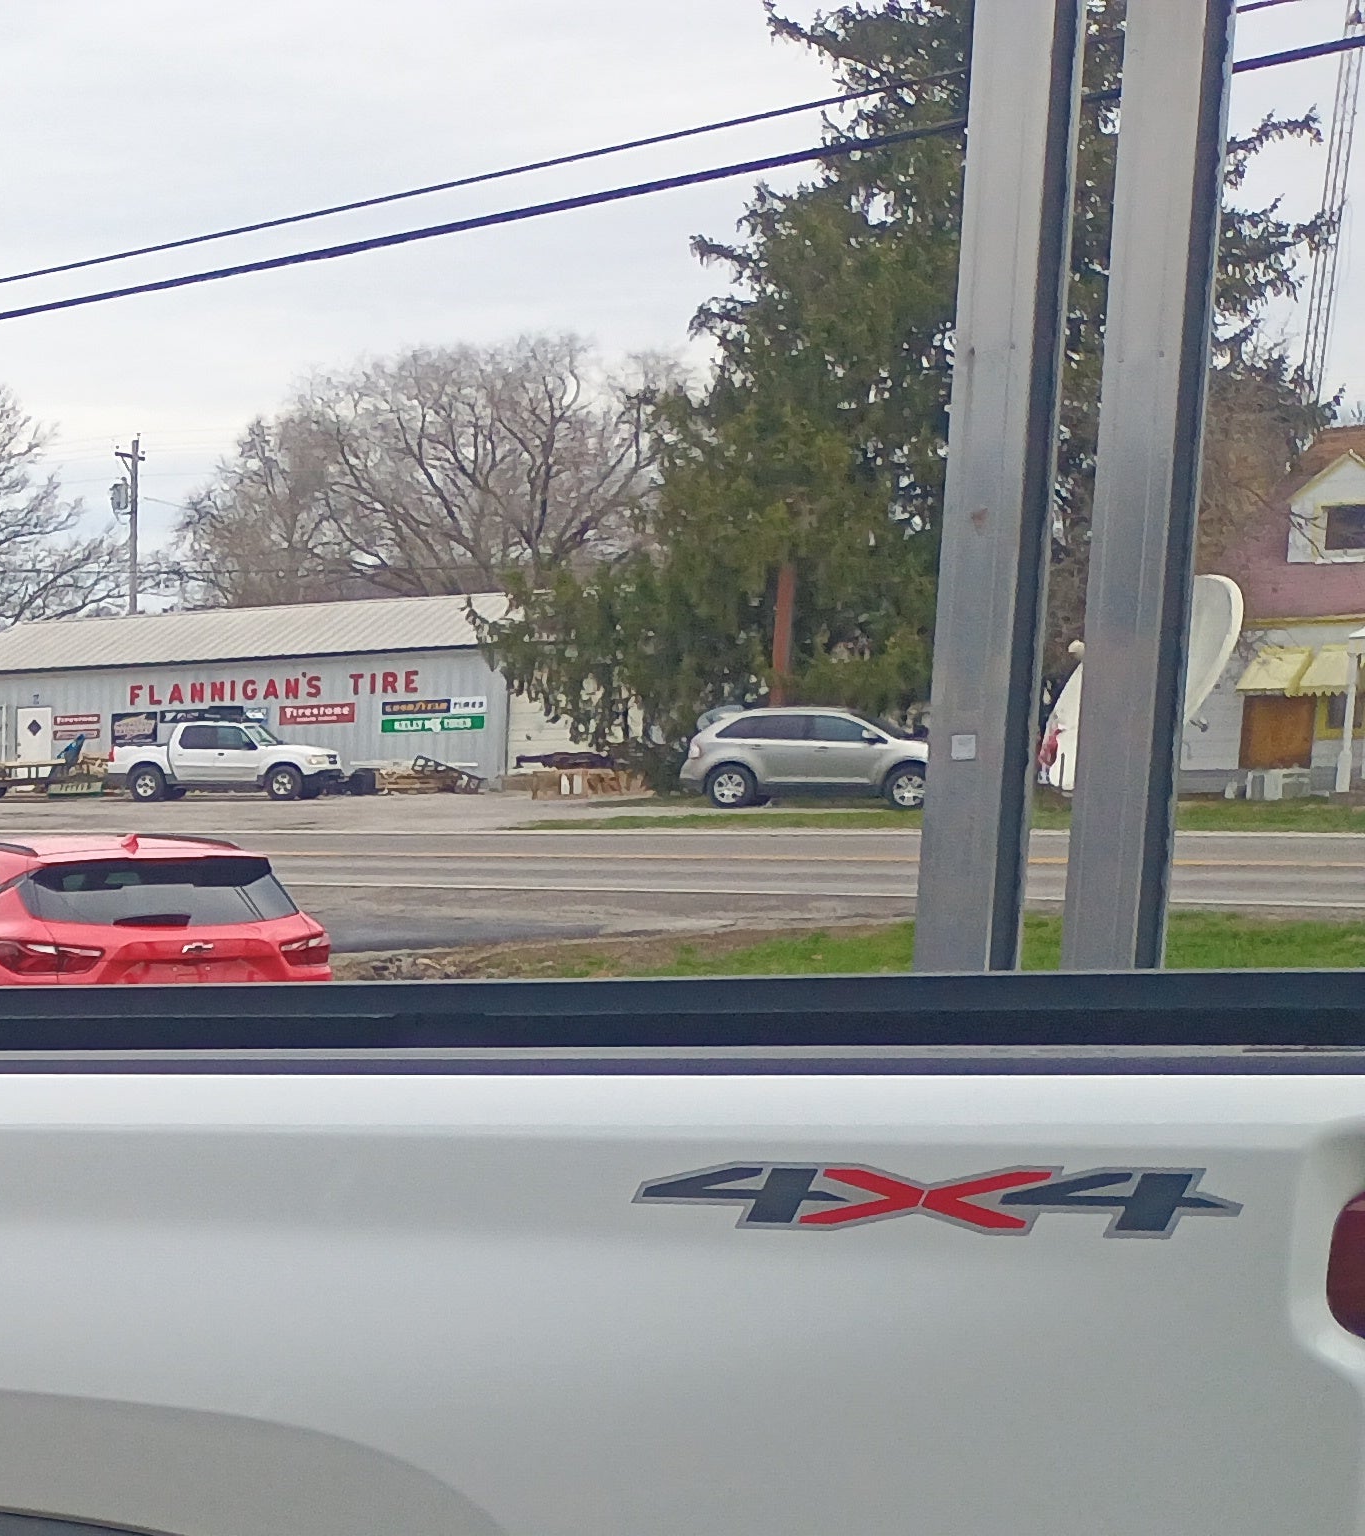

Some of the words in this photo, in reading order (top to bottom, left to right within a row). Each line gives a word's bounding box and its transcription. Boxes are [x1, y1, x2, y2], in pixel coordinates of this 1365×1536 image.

[129, 672, 321, 706] FLANNIGAN'S
[348, 670, 420, 696] TIRE
[284, 706, 350, 719] Firestone
